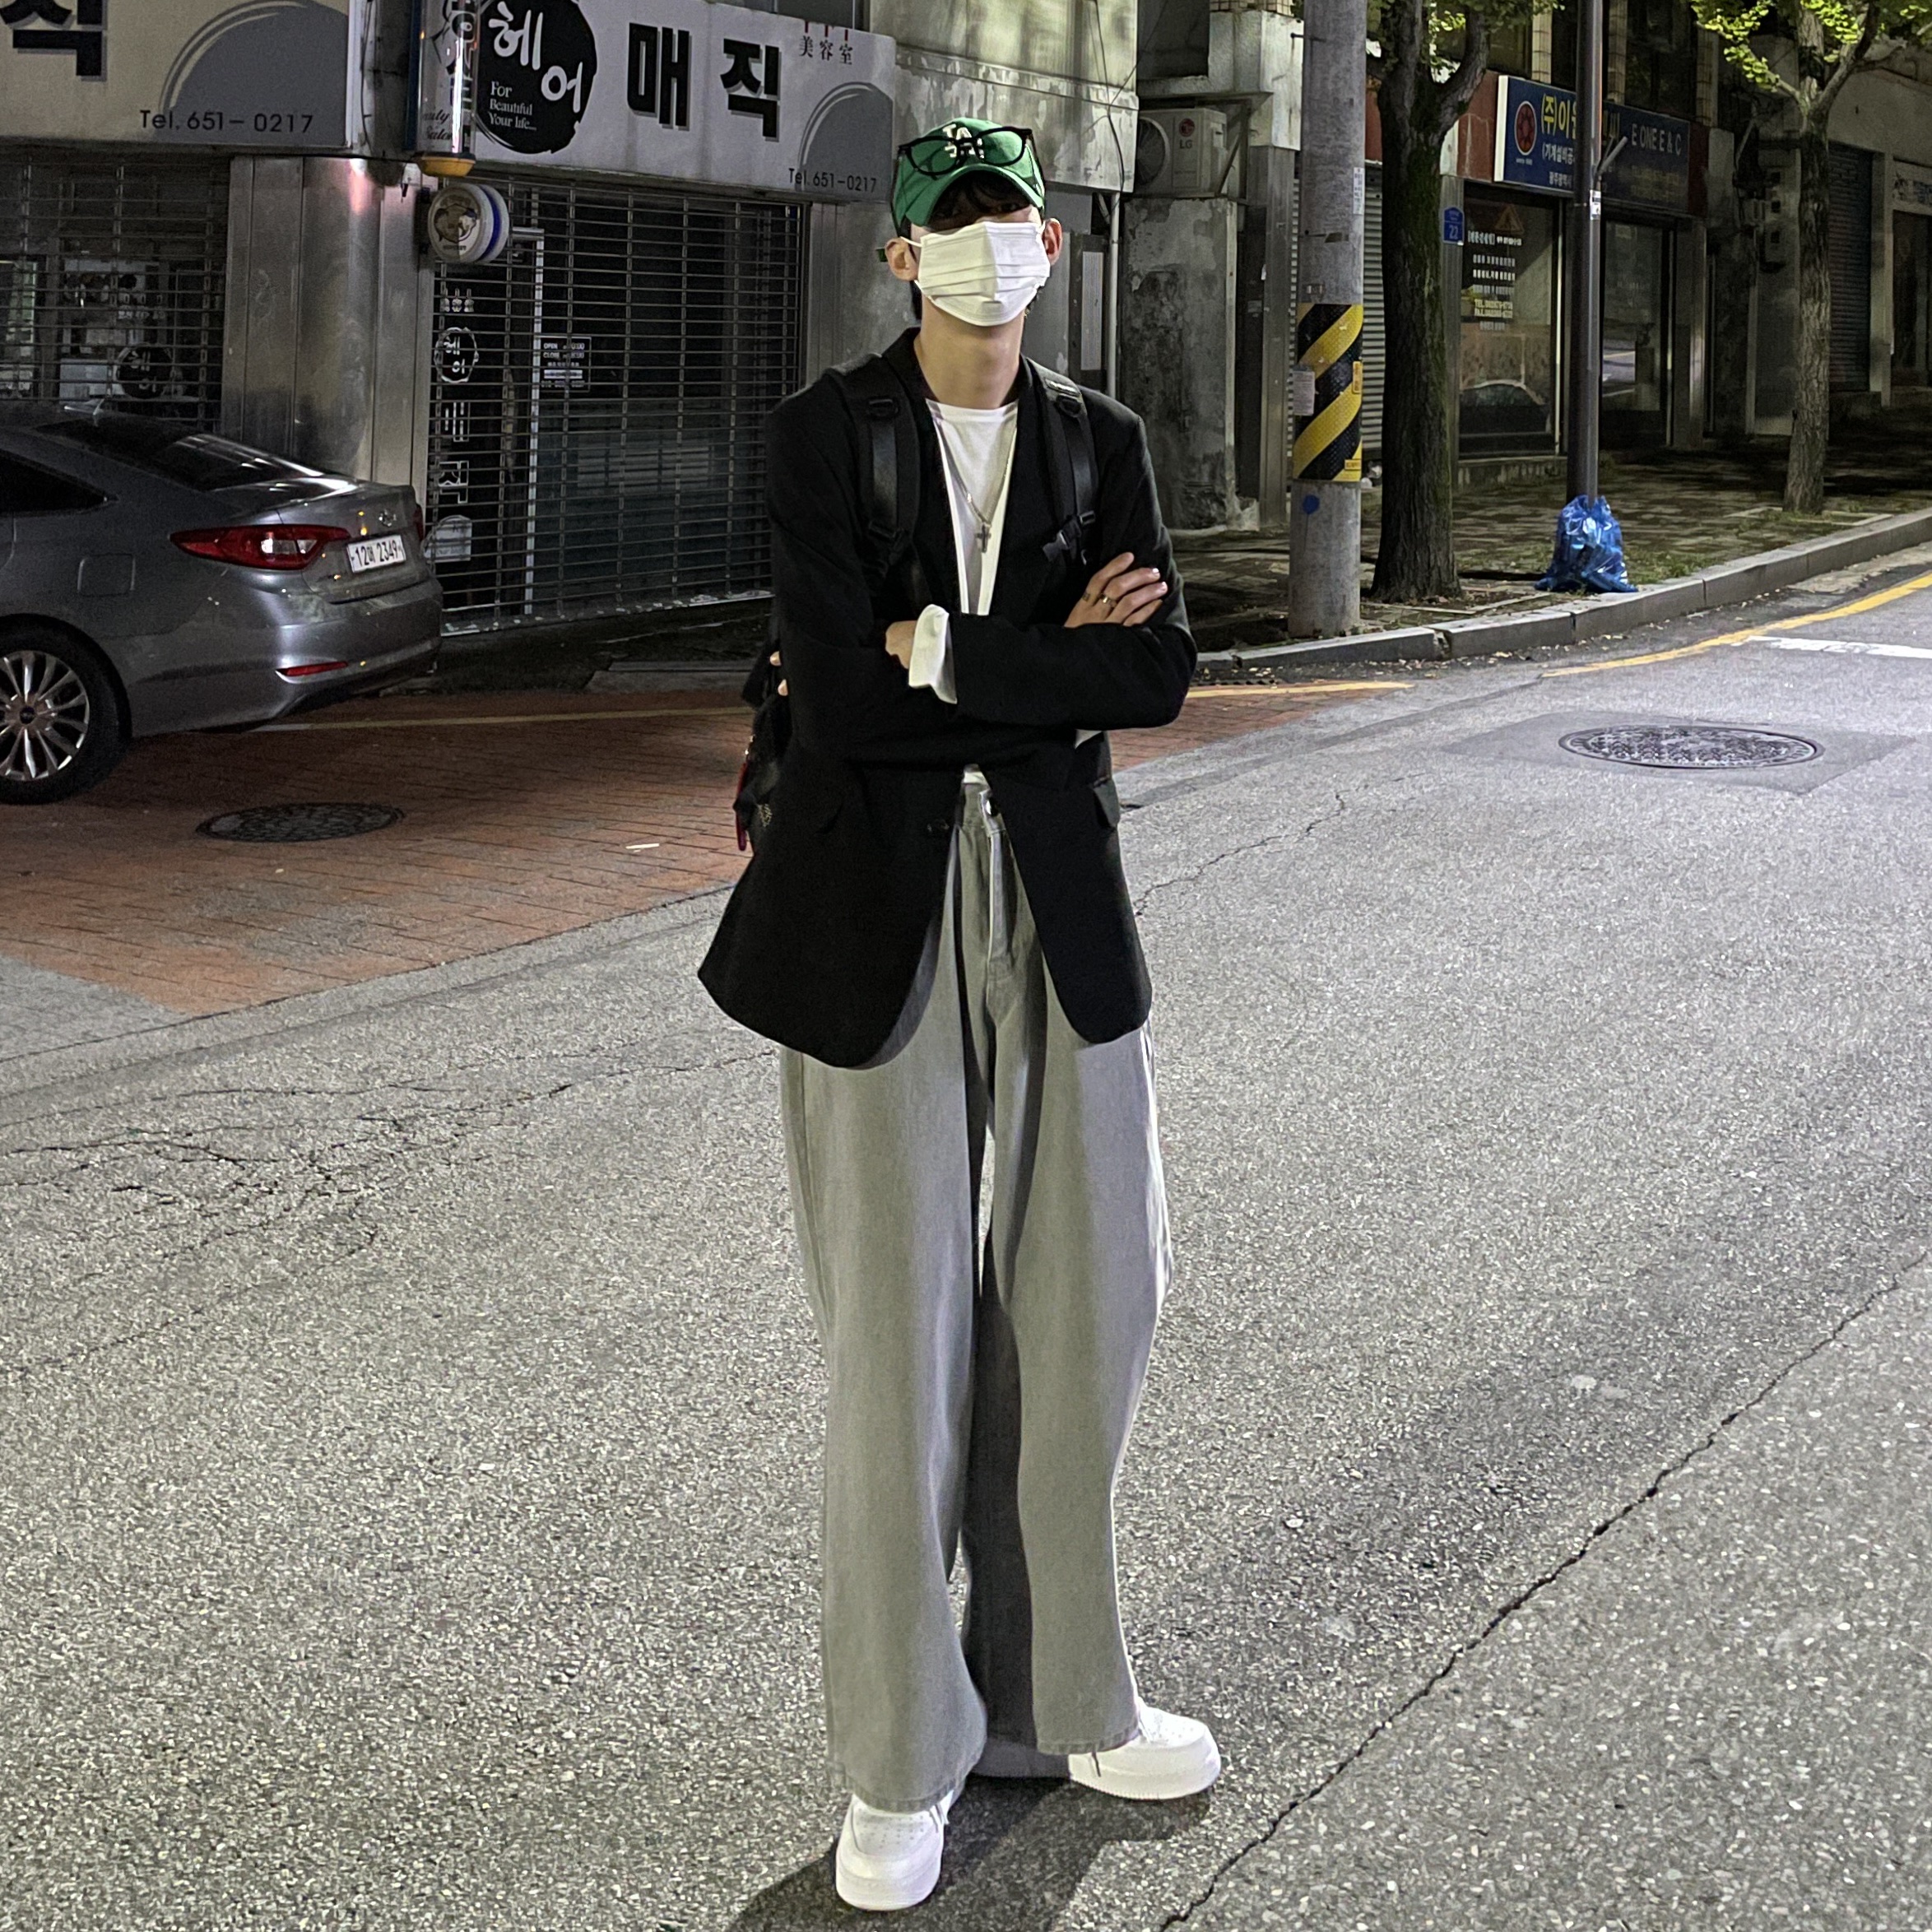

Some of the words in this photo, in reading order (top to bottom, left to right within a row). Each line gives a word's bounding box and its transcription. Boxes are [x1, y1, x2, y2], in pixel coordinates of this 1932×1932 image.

[488, 1, 583, 113] 헤어
[798, 35, 853, 65] 美容室
[490, 81, 513, 98] For
[490, 99, 532, 116] Beautiful
[488, 111, 513, 125] Your
[1179, 140, 1193, 149] LG
[1631, 123, 1638, 146] E
[1639, 125, 1657, 150] ONE
[1659, 129, 1665, 151] E
[1674, 133, 1682, 156] C
[1448, 224, 1459, 240] 22
